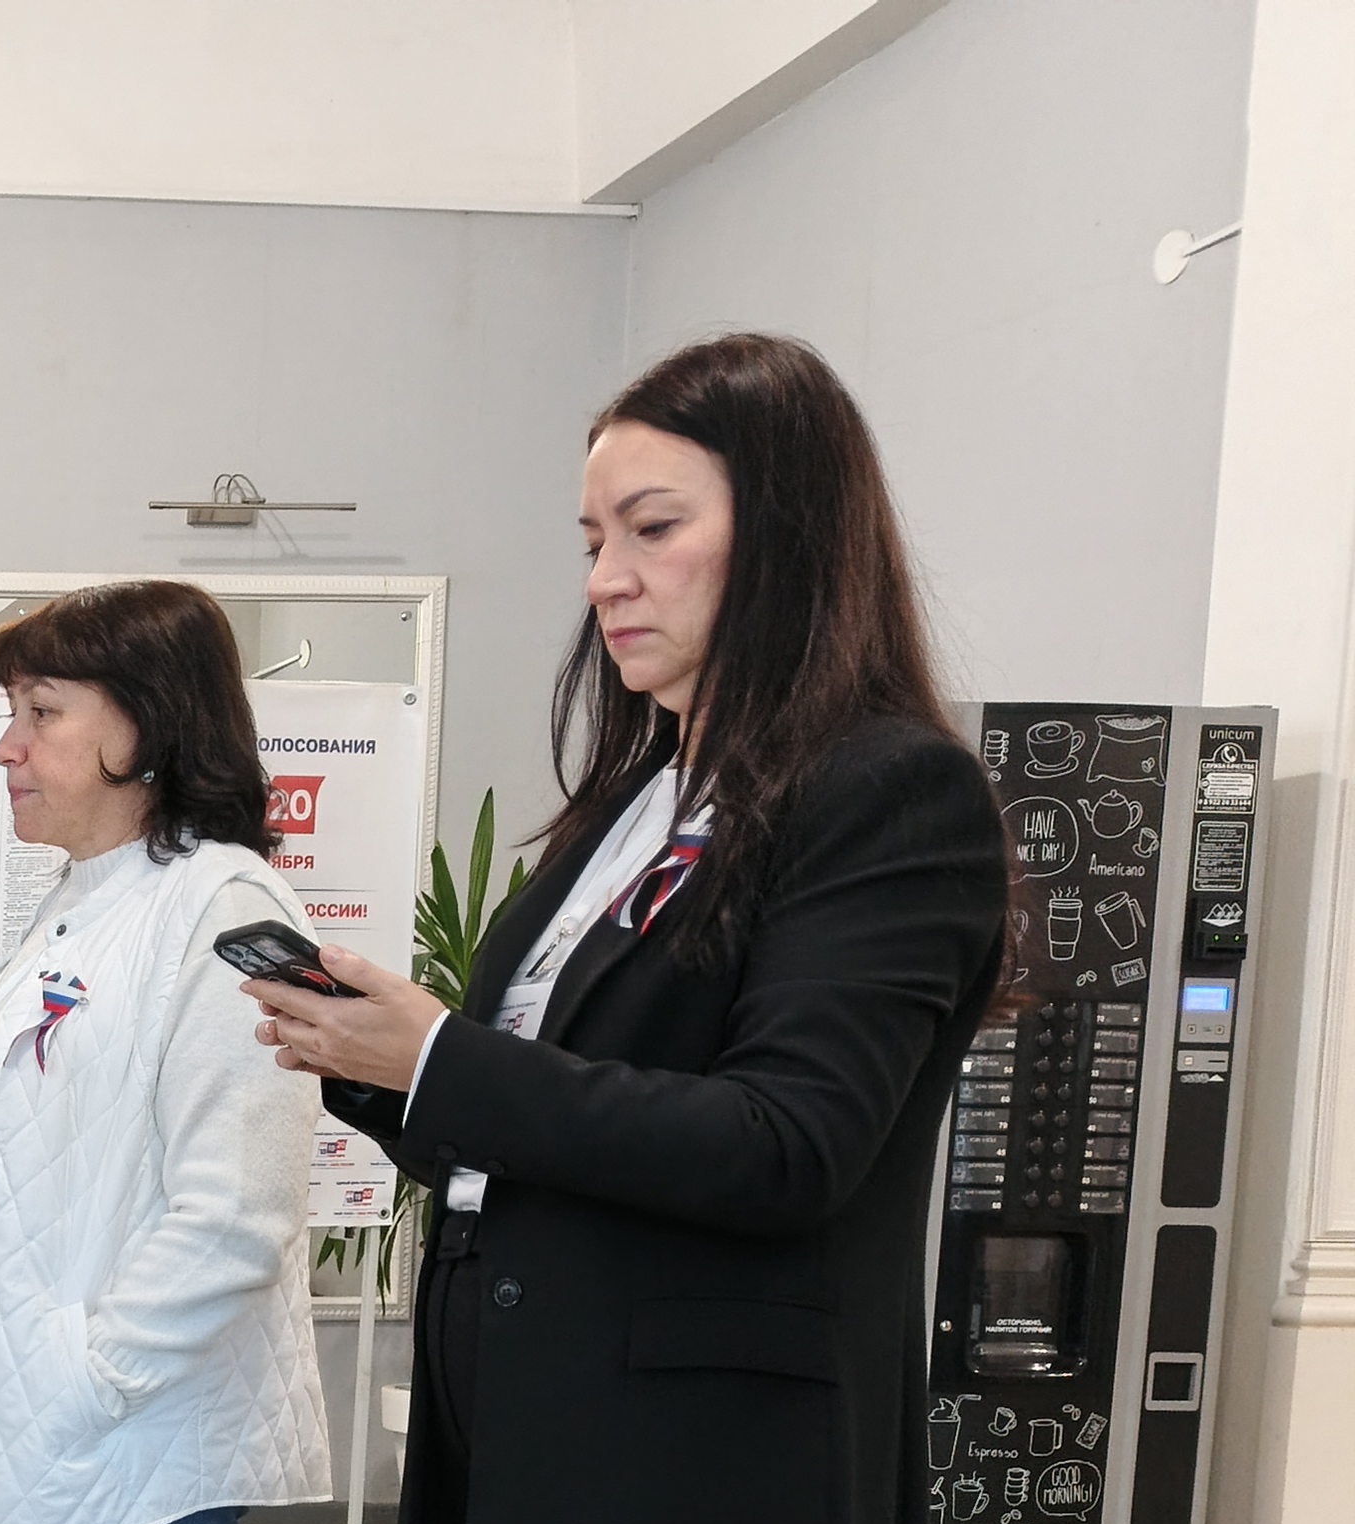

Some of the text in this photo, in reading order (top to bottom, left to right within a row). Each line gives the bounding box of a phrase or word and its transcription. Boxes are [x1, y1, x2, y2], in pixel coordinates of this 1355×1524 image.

[1209, 727, 1255, 741] unicum
[269, 788, 313, 822] 20
[1024, 810, 1057, 839] HAVE
[1017, 842, 1065, 862] NICE DAY!
[1089, 854, 1145, 876] Americano
[305, 903, 368, 918] ОССИИ!
[1005, 1041, 1016, 1049] 40
[968, 1441, 1019, 1462] Espresso
[1051, 1466, 1081, 1486] GOOD
[1044, 1483, 1093, 1506] MORNING!
